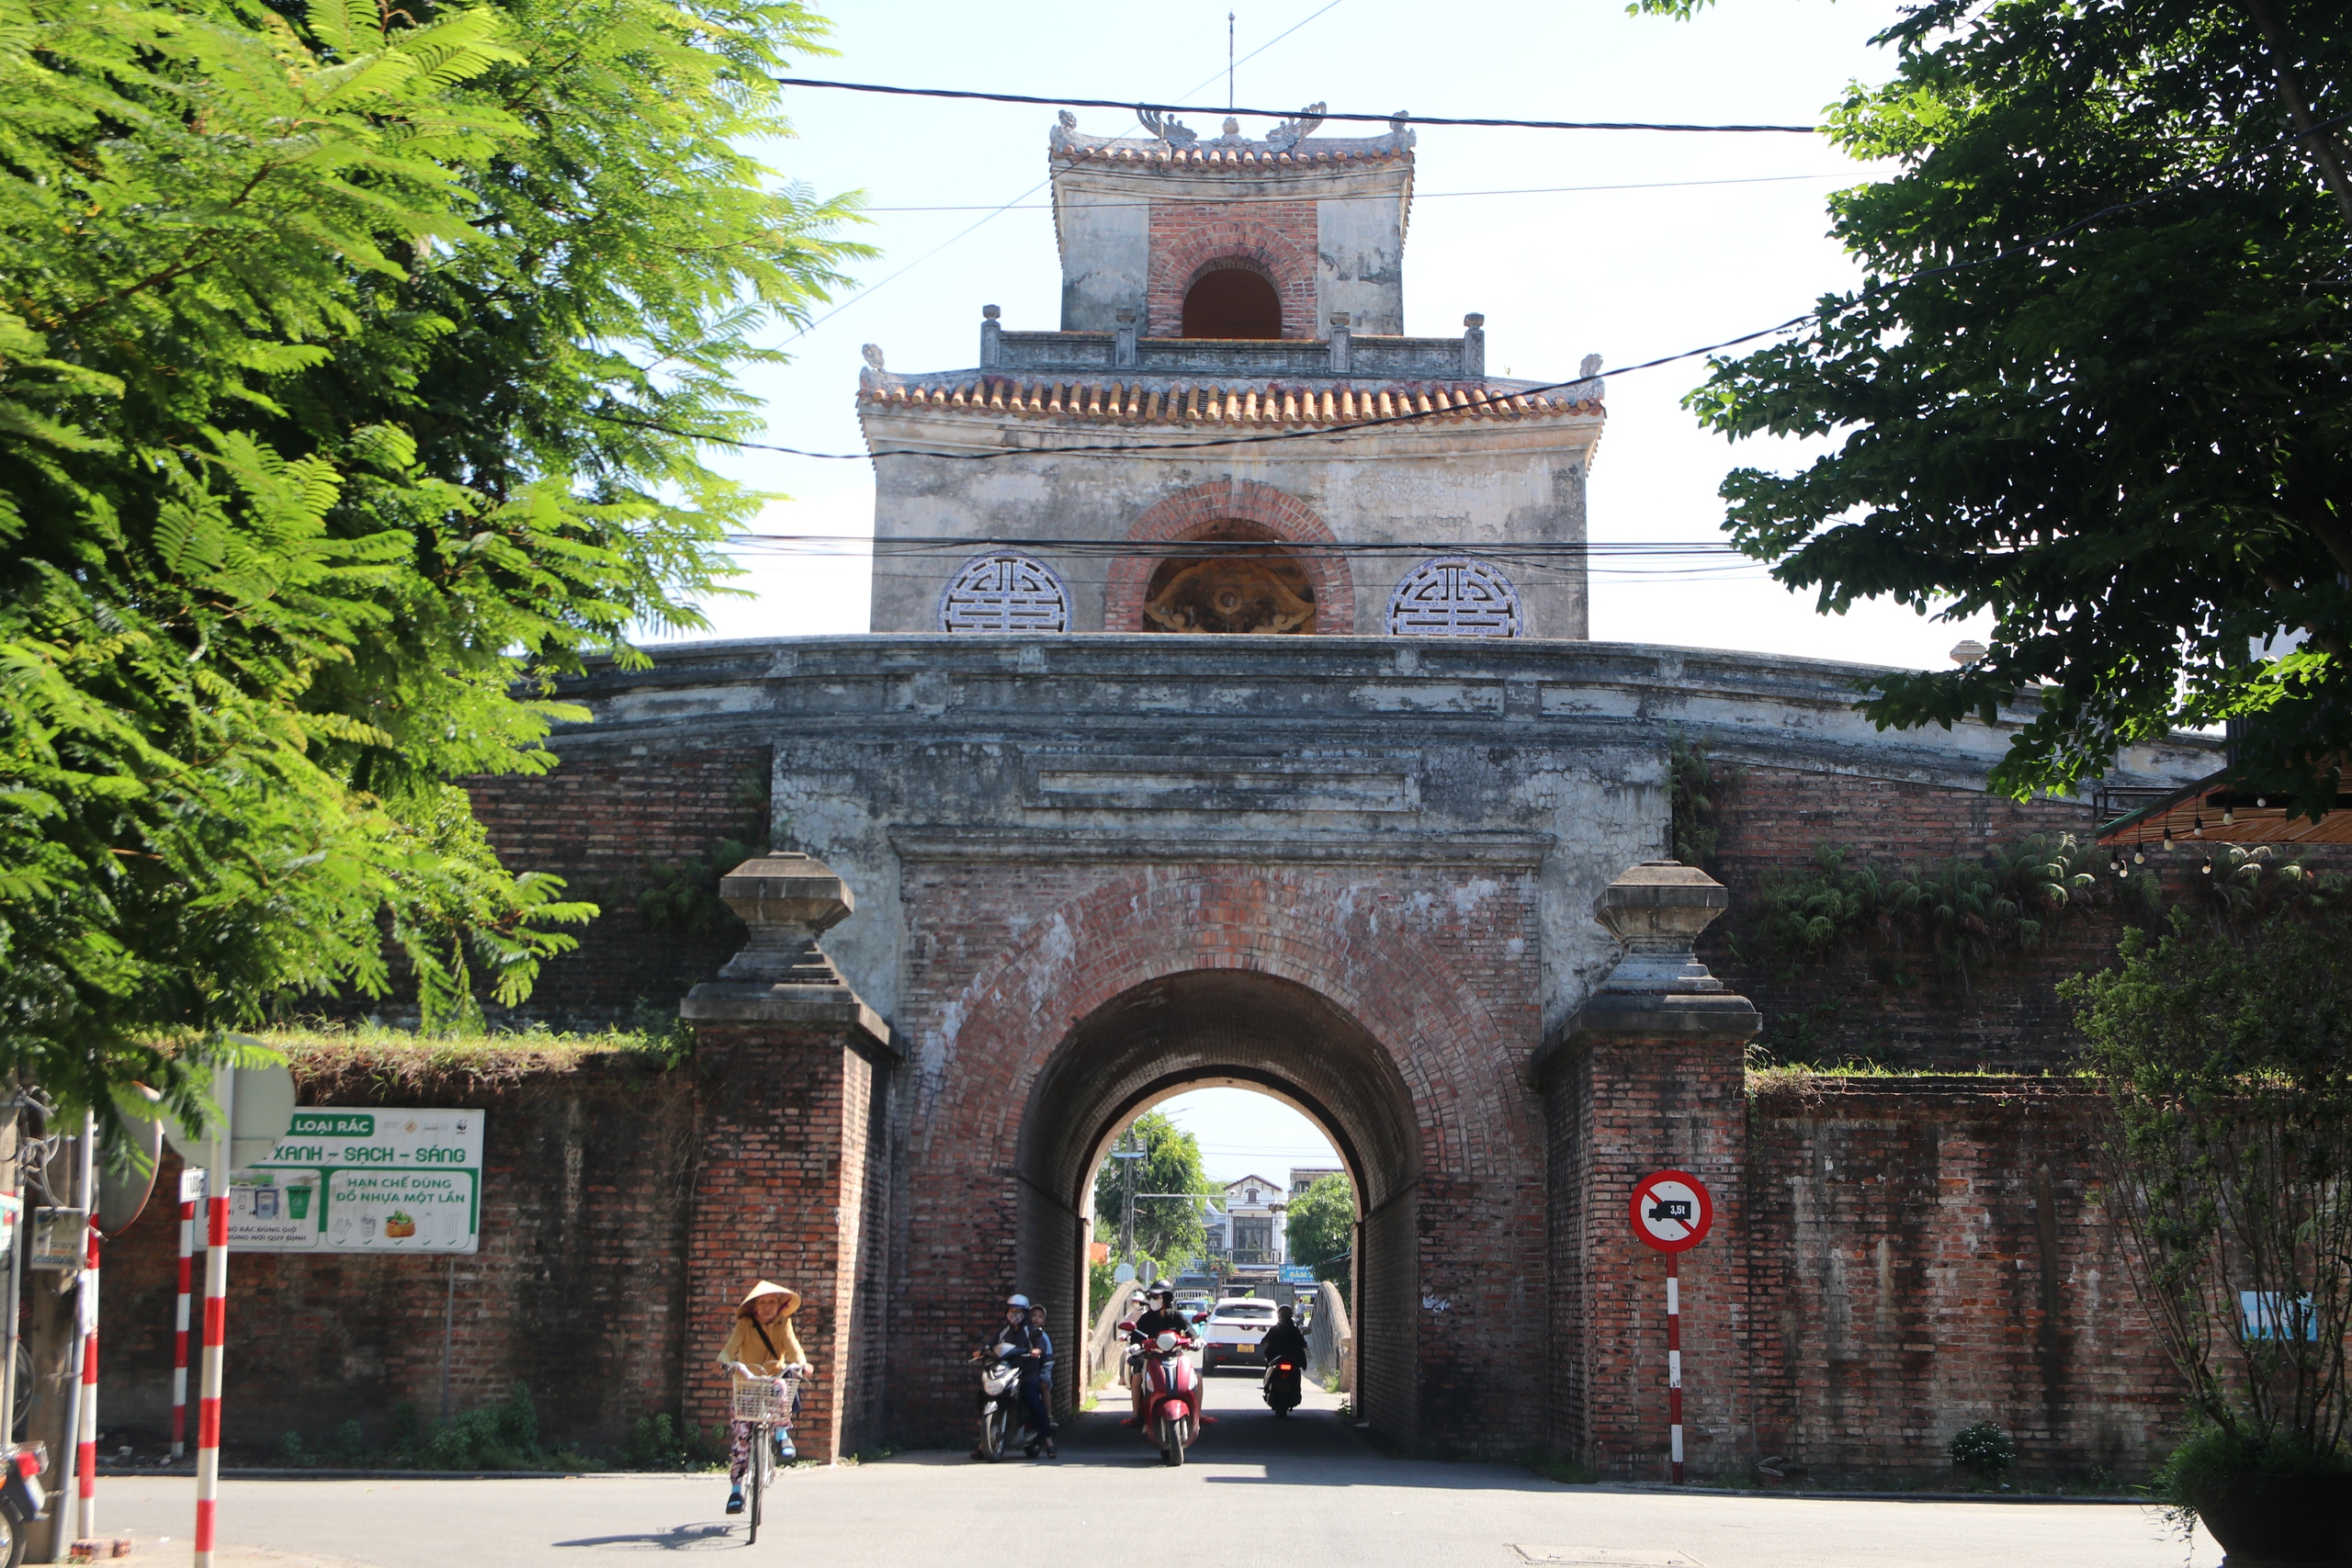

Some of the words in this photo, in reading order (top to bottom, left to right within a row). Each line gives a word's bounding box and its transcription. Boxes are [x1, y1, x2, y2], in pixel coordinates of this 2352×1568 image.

[296, 1120, 334, 1134] LOẠI
[336, 1117, 369, 1133] RÁC
[274, 1145, 323, 1161] XANH
[344, 1146, 394, 1165] SẠCH
[415, 1144, 466, 1163] SÁNG
[348, 1178, 378, 1190] HẠN
[381, 1175, 411, 1189] CHẾ
[412, 1177, 452, 1189] DÙNG
[360, 1192, 401, 1204] NHỰA
[404, 1191, 436, 1204] MỘT
[1670, 1205, 1685, 1215] 3,5t
